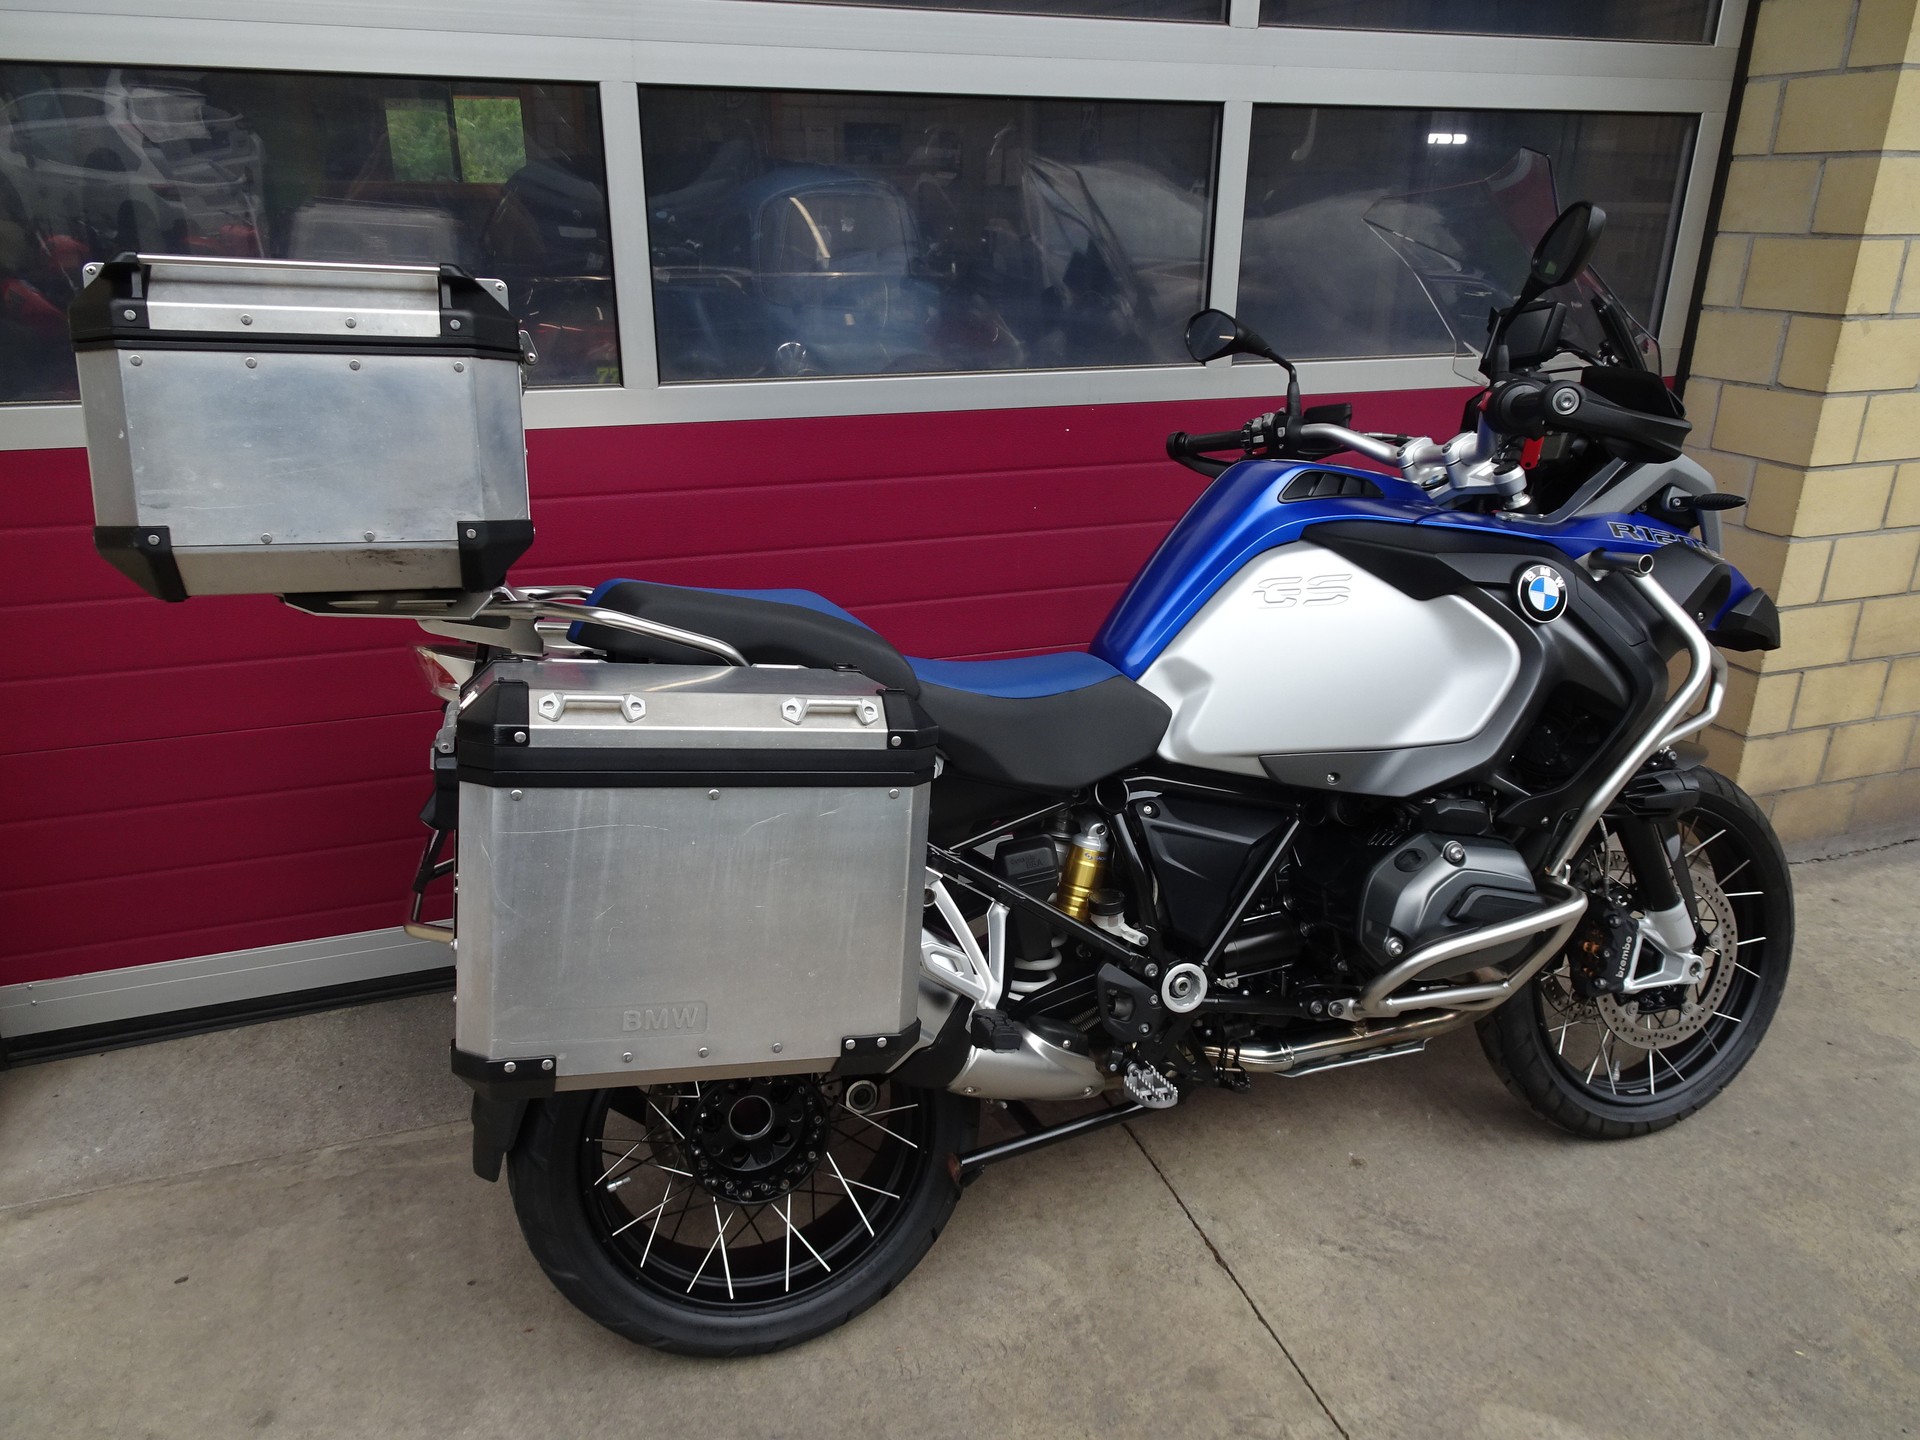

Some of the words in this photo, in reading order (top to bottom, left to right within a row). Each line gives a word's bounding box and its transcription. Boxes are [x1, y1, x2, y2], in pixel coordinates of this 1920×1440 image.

[1252, 573, 1353, 609] GS
[1524, 567, 1565, 588] BMW
[1616, 936, 1632, 978] brembo
[622, 1007, 699, 1032] BMW
